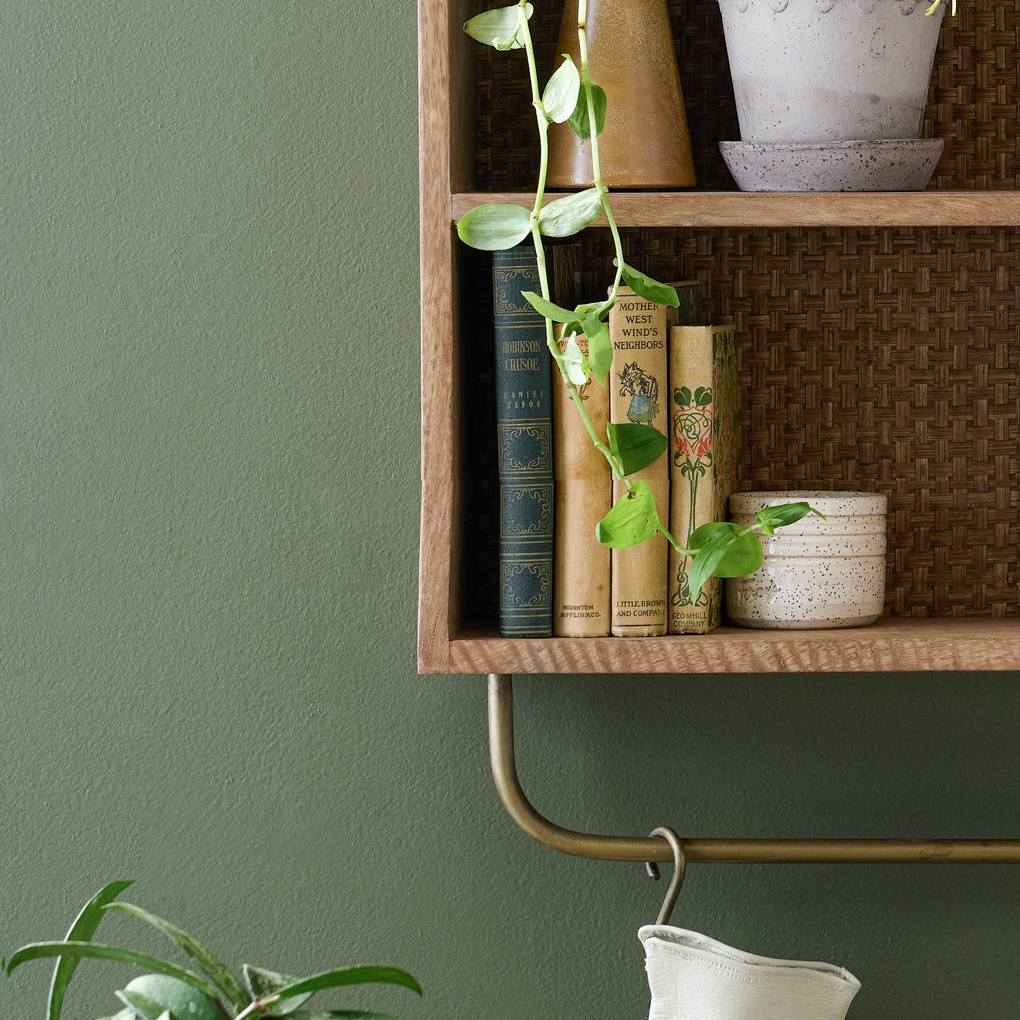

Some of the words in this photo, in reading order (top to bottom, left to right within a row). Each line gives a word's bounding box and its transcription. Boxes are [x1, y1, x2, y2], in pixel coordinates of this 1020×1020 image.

[619, 302, 660, 311] MOTHER
[625, 314, 654, 324] WEST
[622, 327, 659, 337] WIND'S
[502, 340, 541, 354] ROBINSON
[613, 340, 664, 350] NEIGHBORS
[504, 358, 540, 372] CRUSOE
[672, 620, 706, 628] COMPANY
